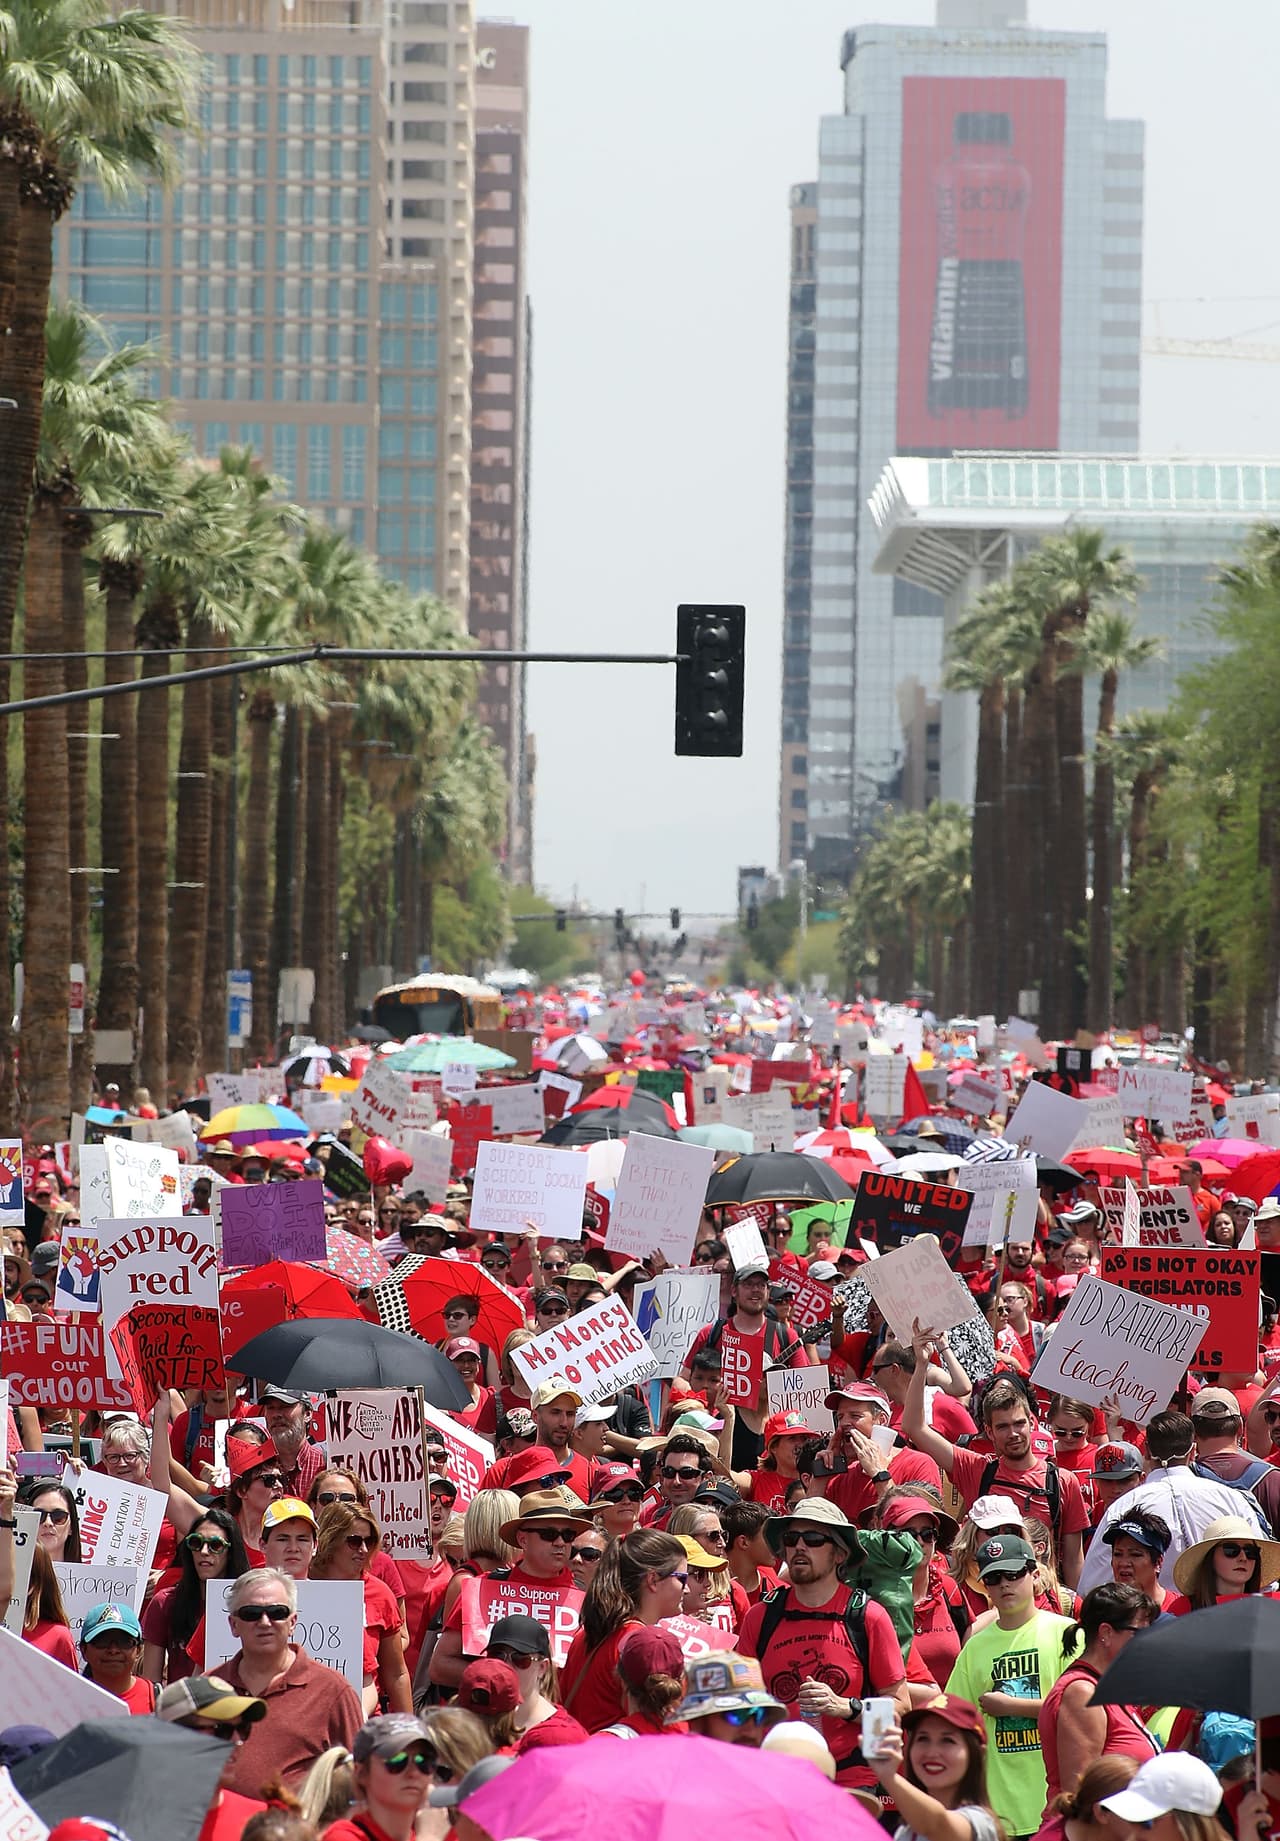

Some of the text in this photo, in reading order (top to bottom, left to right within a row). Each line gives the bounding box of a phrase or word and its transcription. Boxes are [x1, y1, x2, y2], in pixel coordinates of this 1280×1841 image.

[929, 258, 959, 380] vitamin
[489, 1148, 553, 1171] SUPPORT
[482, 1167, 585, 1190] SCHOOL SOCIAL
[864, 1174, 969, 1211] UNITED
[245, 1184, 299, 1208] WE
[903, 1203, 923, 1215] WE
[1103, 1189, 1176, 1207] ARIONA
[226, 1201, 324, 1233] DO IT
[1107, 1209, 1191, 1228] STENTS
[223, 1231, 271, 1264] FOR
[1113, 1226, 1183, 1246] DERVE
[95, 1225, 217, 1281] support
[1132, 1257, 1152, 1272] IS
[1157, 1258, 1198, 1273] NOT
[1205, 1258, 1259, 1276] OKAY
[127, 1265, 193, 1296] red
[127, 1307, 189, 1336] Second
[664, 1280, 719, 1336] Pupils
[1070, 1282, 1203, 1363] I'D RATHER BE
[2, 1324, 100, 1357] #FUN
[552, 1303, 631, 1352] Money
[139, 1330, 170, 1359] Paid
[175, 1332, 205, 1356] for
[584, 1327, 644, 1374] minds
[50, 1359, 91, 1373] our
[1058, 1339, 1158, 1422] teaching
[6, 1372, 133, 1406] SCHOOLS
[782, 1370, 804, 1392] We
[769, 1387, 829, 1415] SUPPORT
[326, 1396, 420, 1442] WE ARE
[75, 1487, 87, 1506] be
[132, 1494, 147, 1528] FUTURE
[126, 1533, 139, 1550] THE
[500, 1584, 561, 1604] We Support
[292, 1621, 342, 1651] 008
[991, 1653, 1039, 1681] MAUI
